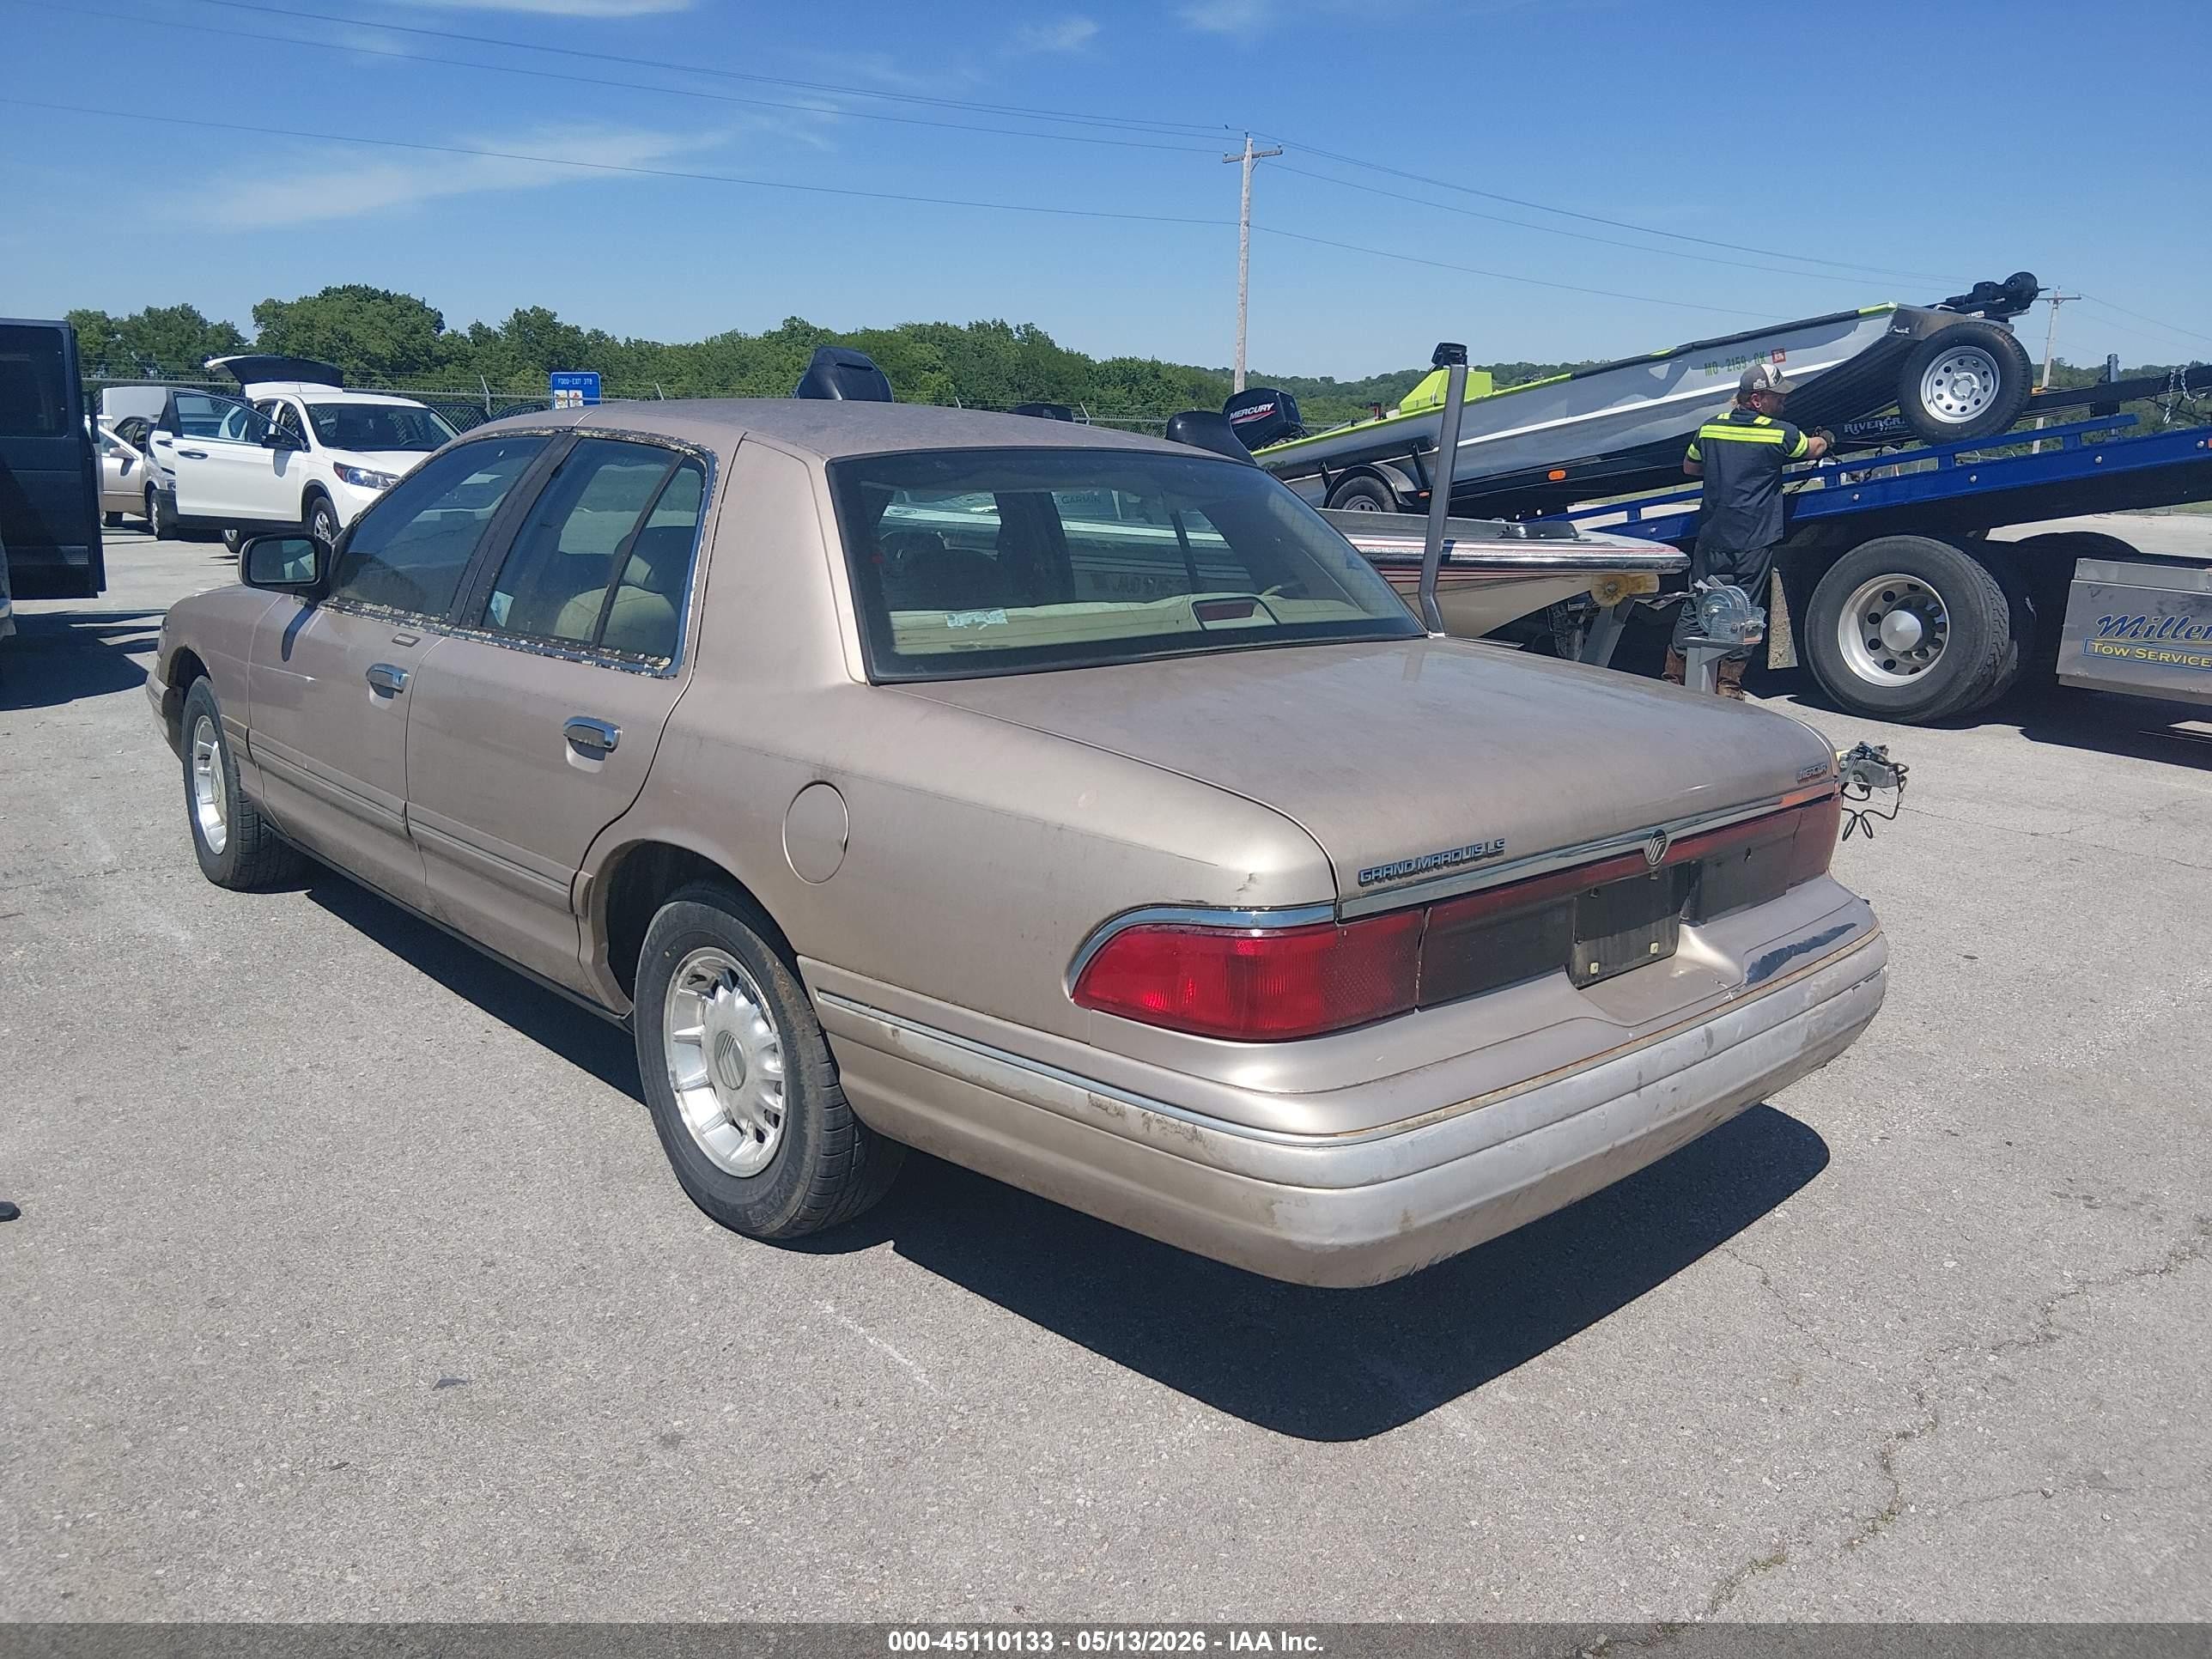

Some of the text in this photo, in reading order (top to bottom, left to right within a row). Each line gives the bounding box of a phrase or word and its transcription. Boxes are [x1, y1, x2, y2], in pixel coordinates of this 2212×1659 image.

[1704, 362, 1718, 376] MO
[1725, 355, 1747, 372] 2159
[1230, 402, 1275, 420] MERCURY
[1359, 837, 1505, 884] GRAND MARQUIS LS
